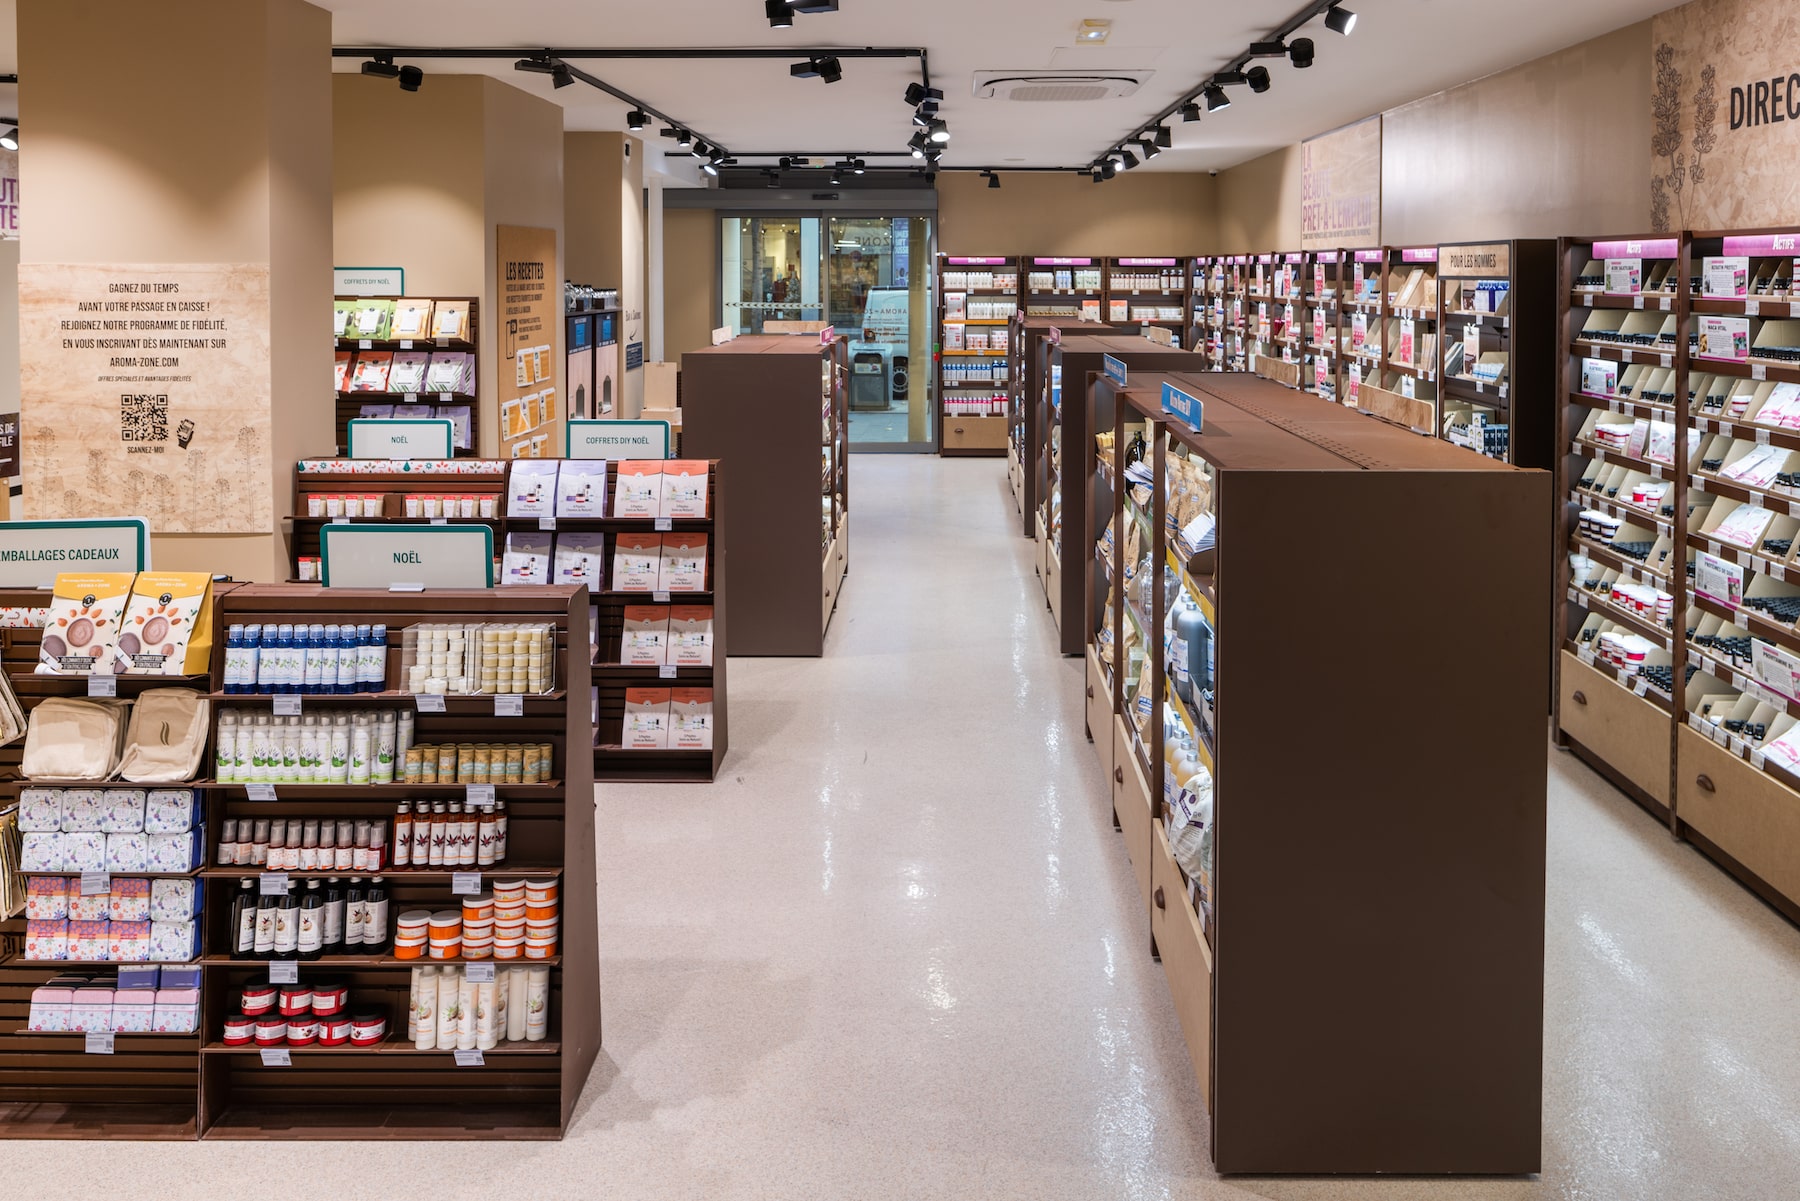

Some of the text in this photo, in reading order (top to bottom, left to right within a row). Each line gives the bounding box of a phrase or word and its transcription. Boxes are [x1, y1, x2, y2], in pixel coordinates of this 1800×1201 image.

[1730, 73, 1800, 130] DIREC
[1450, 254, 1496, 268] POUR LES HOMMES
[506, 261, 544, 280] LES RECETTES
[109, 283, 179, 293] GAGNEZ DU TEMPS
[78, 302, 102, 312] AVANT
[105, 302, 129, 312] VOTRE
[131, 302, 165, 312] PASSAGE
[166, 302, 177, 312] EN
[178, 302, 205, 312] CAISSE
[61, 318, 228, 331] REJOIGNEZ NOTRE PROGRAMME DE FIDÉLITÉ,
[62, 337, 227, 349] EN VOUS INSCRIVANT DÈS MAINTENANT SUR
[110, 357, 179, 367] AROMA-ZONE.COM
[391, 435, 408, 444] NOËL
[632, 435, 649, 444] NOËL
[127, 446, 165, 454] SCANNEZ-MOI
[0, 549, 119, 561] MBALLAGES CADEAUX
[393, 551, 422, 564] NOËL
